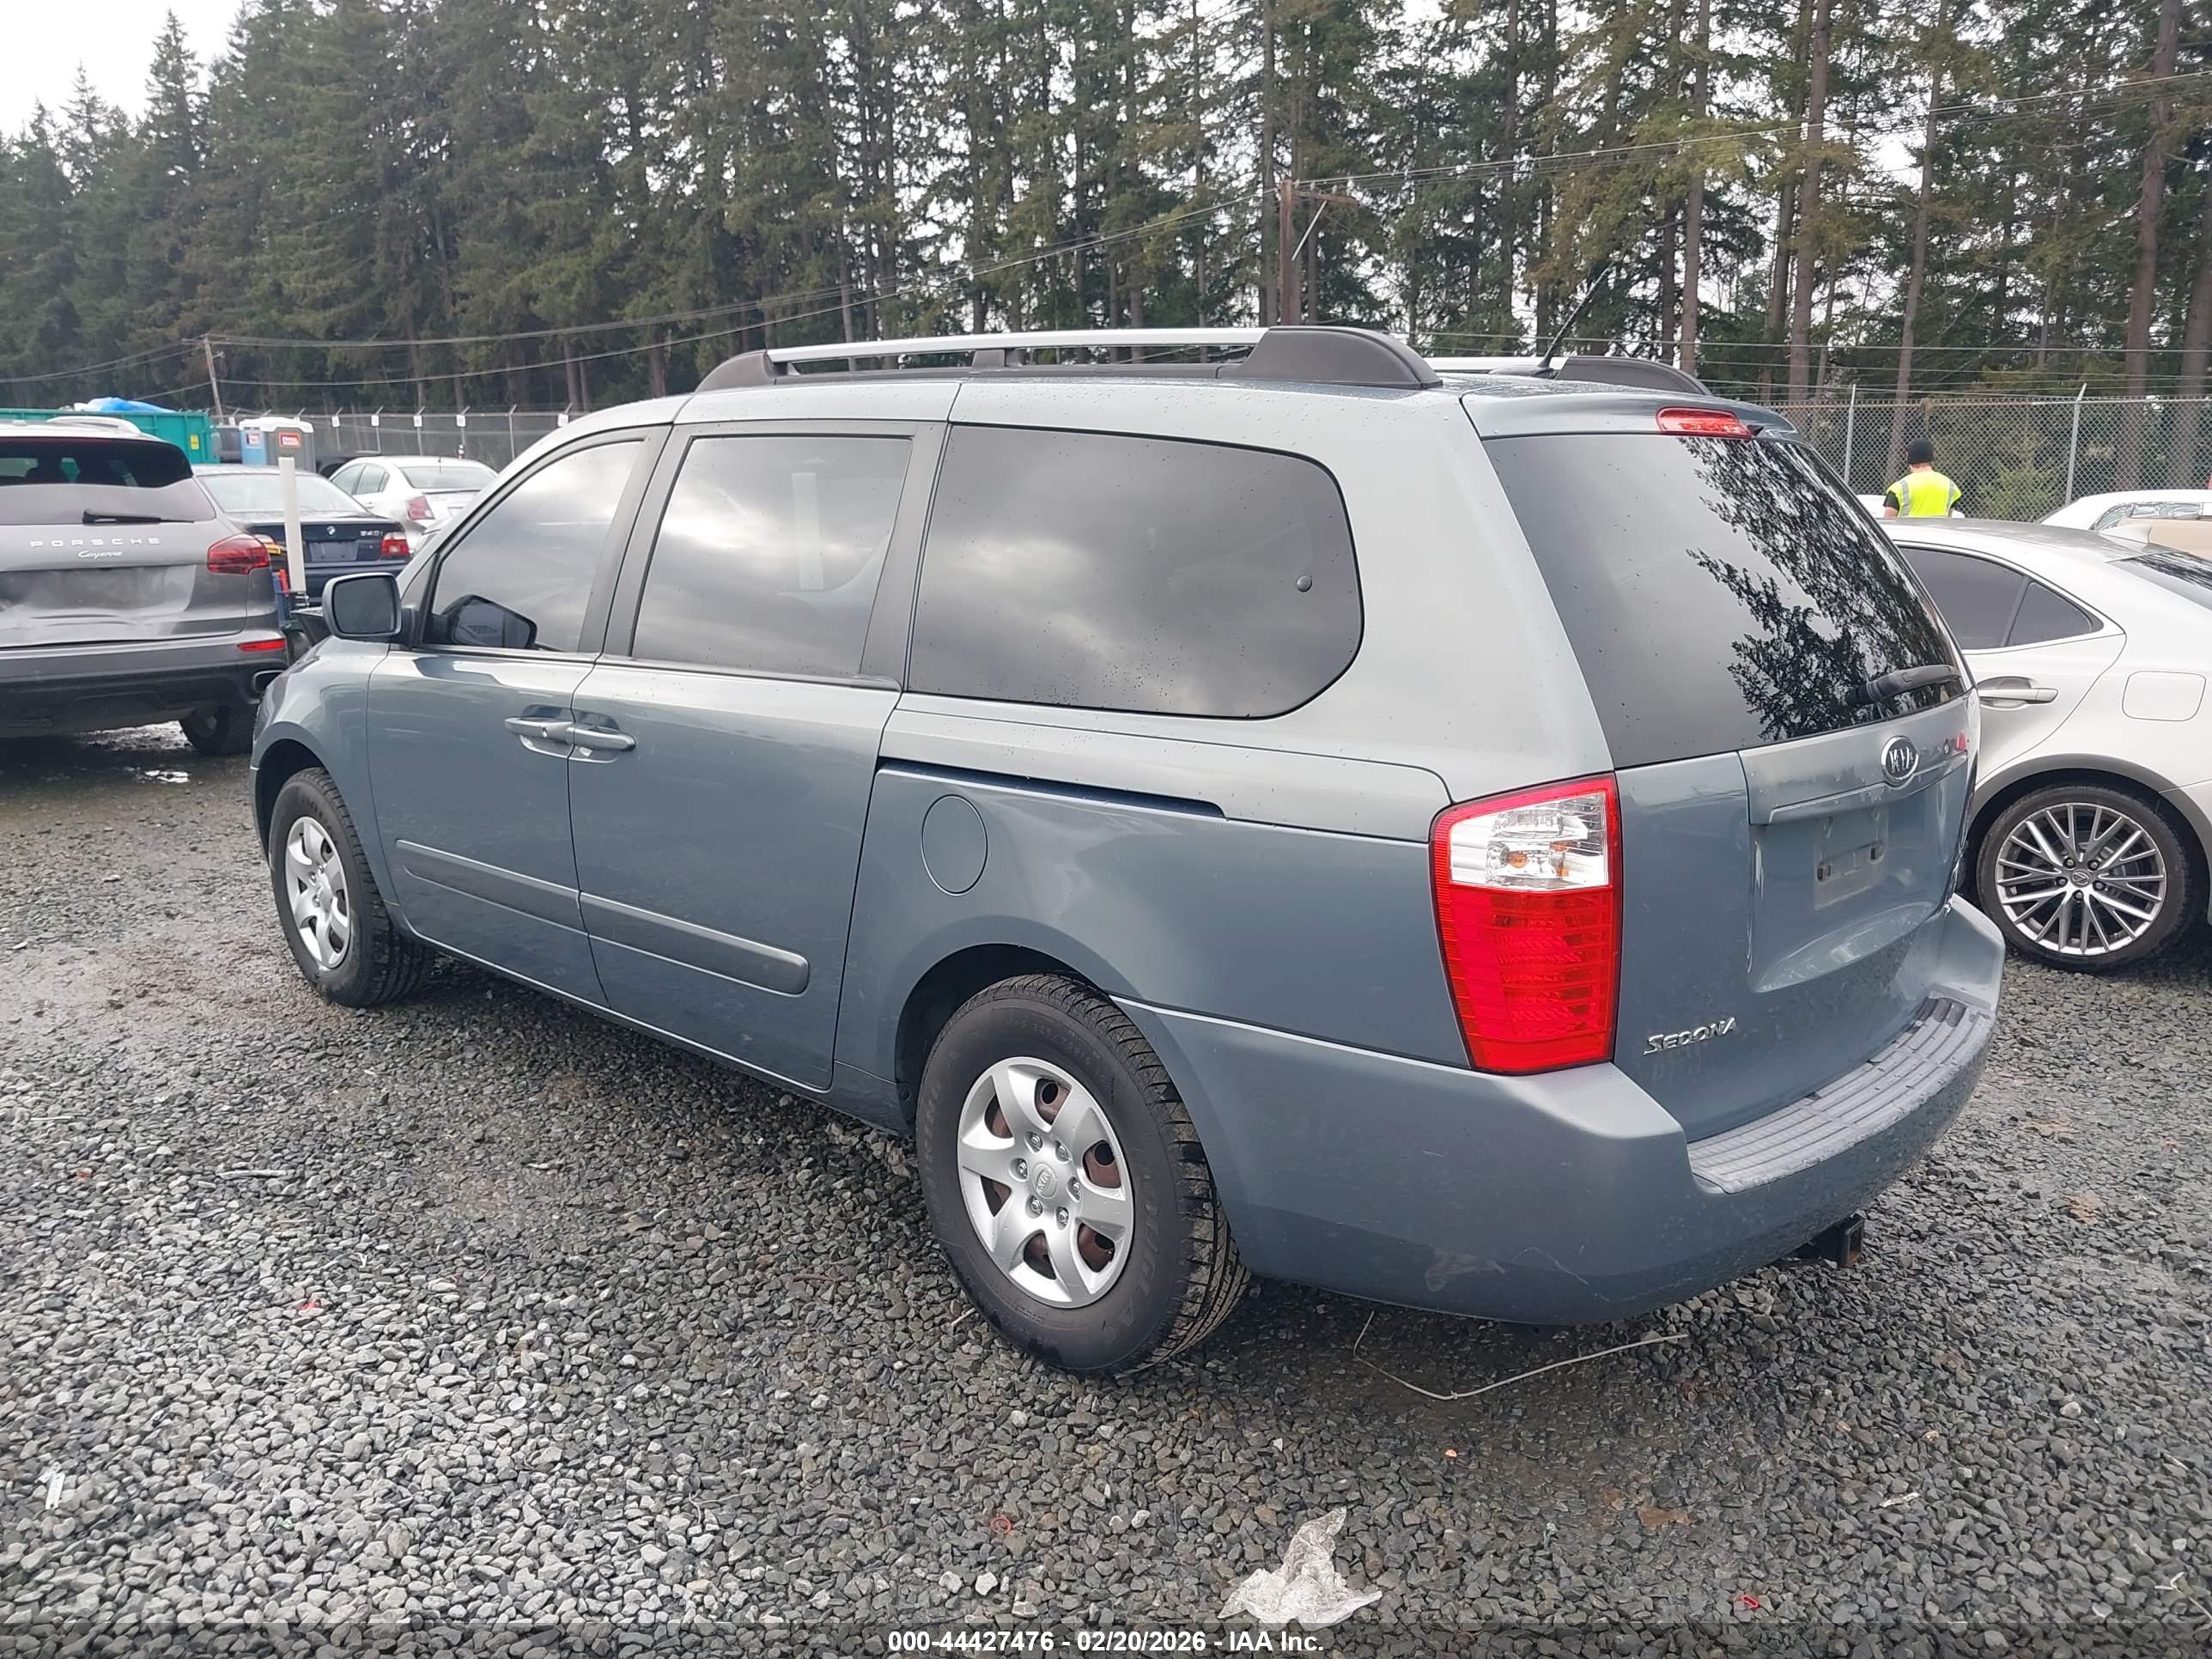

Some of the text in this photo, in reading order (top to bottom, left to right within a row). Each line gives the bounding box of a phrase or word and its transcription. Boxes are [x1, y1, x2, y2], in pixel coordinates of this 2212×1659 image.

[29, 537, 161, 549] PORSCHE
[77, 550, 123, 560] Cayenne
[1642, 1017, 1737, 1056] SEDONA
